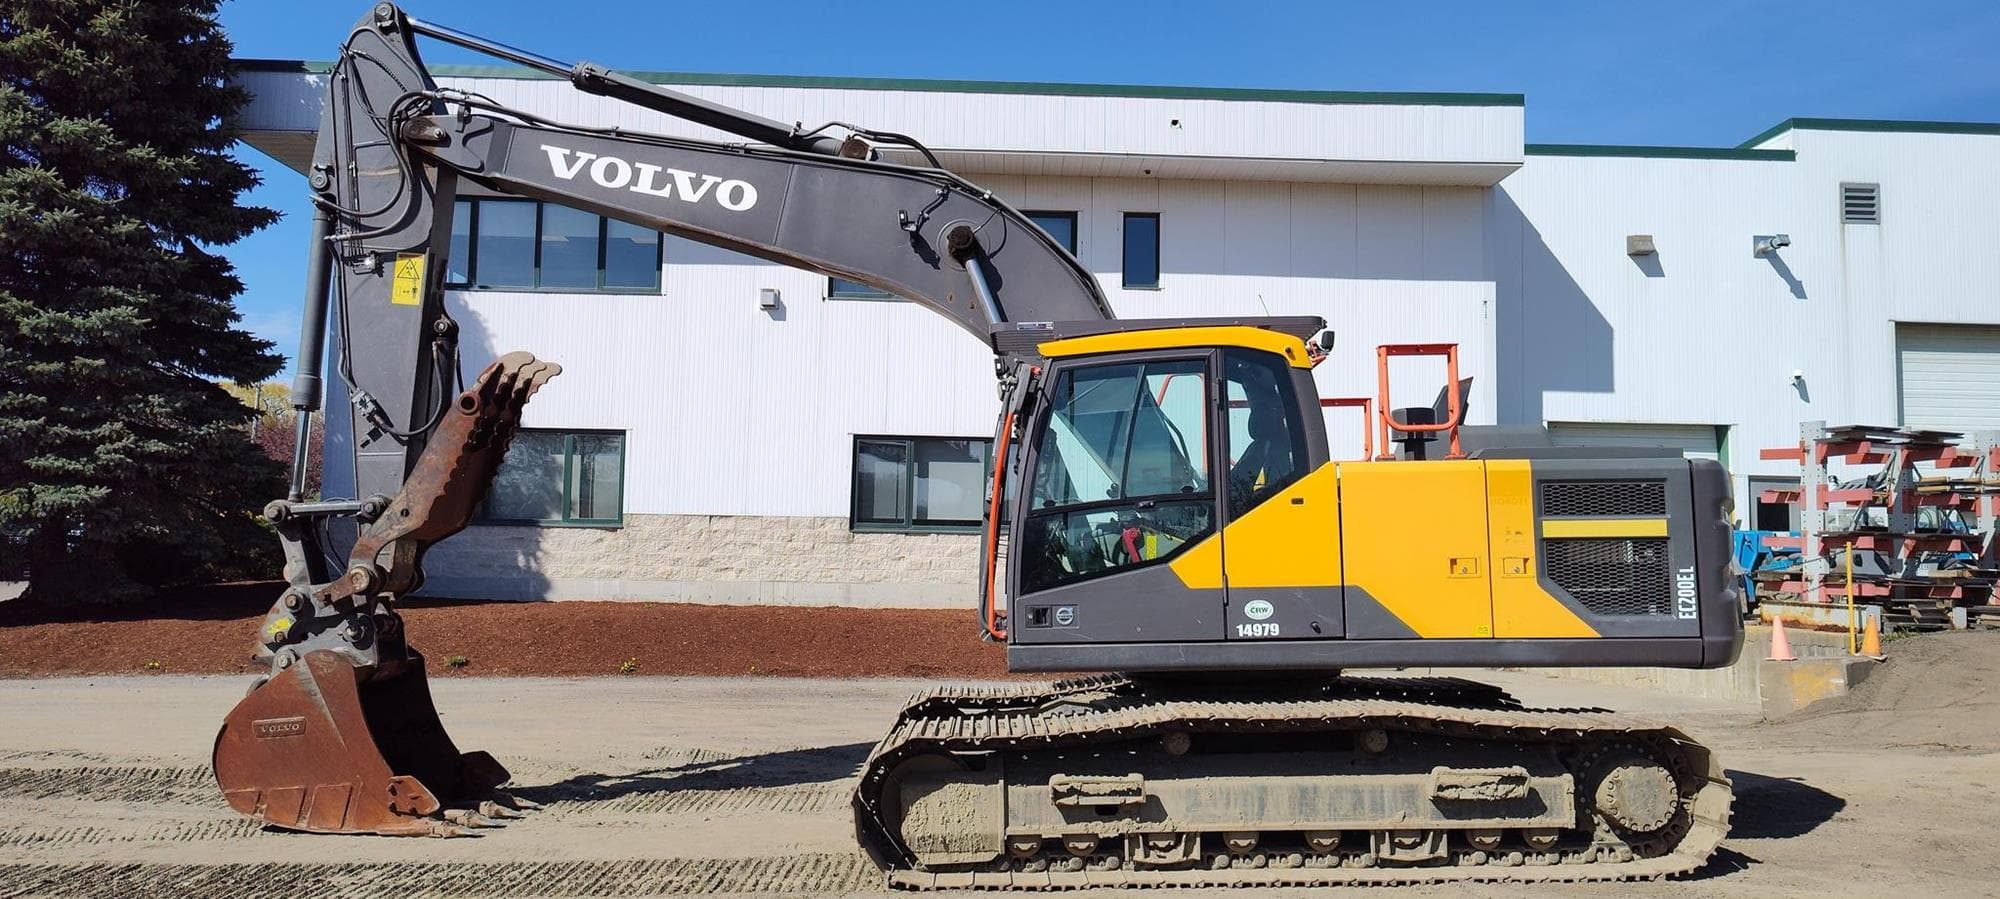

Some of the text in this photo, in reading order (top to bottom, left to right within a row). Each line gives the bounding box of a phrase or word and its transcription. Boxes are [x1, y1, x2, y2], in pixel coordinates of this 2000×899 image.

[541, 144, 758, 212] VOLVO
[1677, 566, 1697, 619] EC200EL
[1236, 623, 1280, 637] 14979
[261, 723, 300, 732] VOLVO
